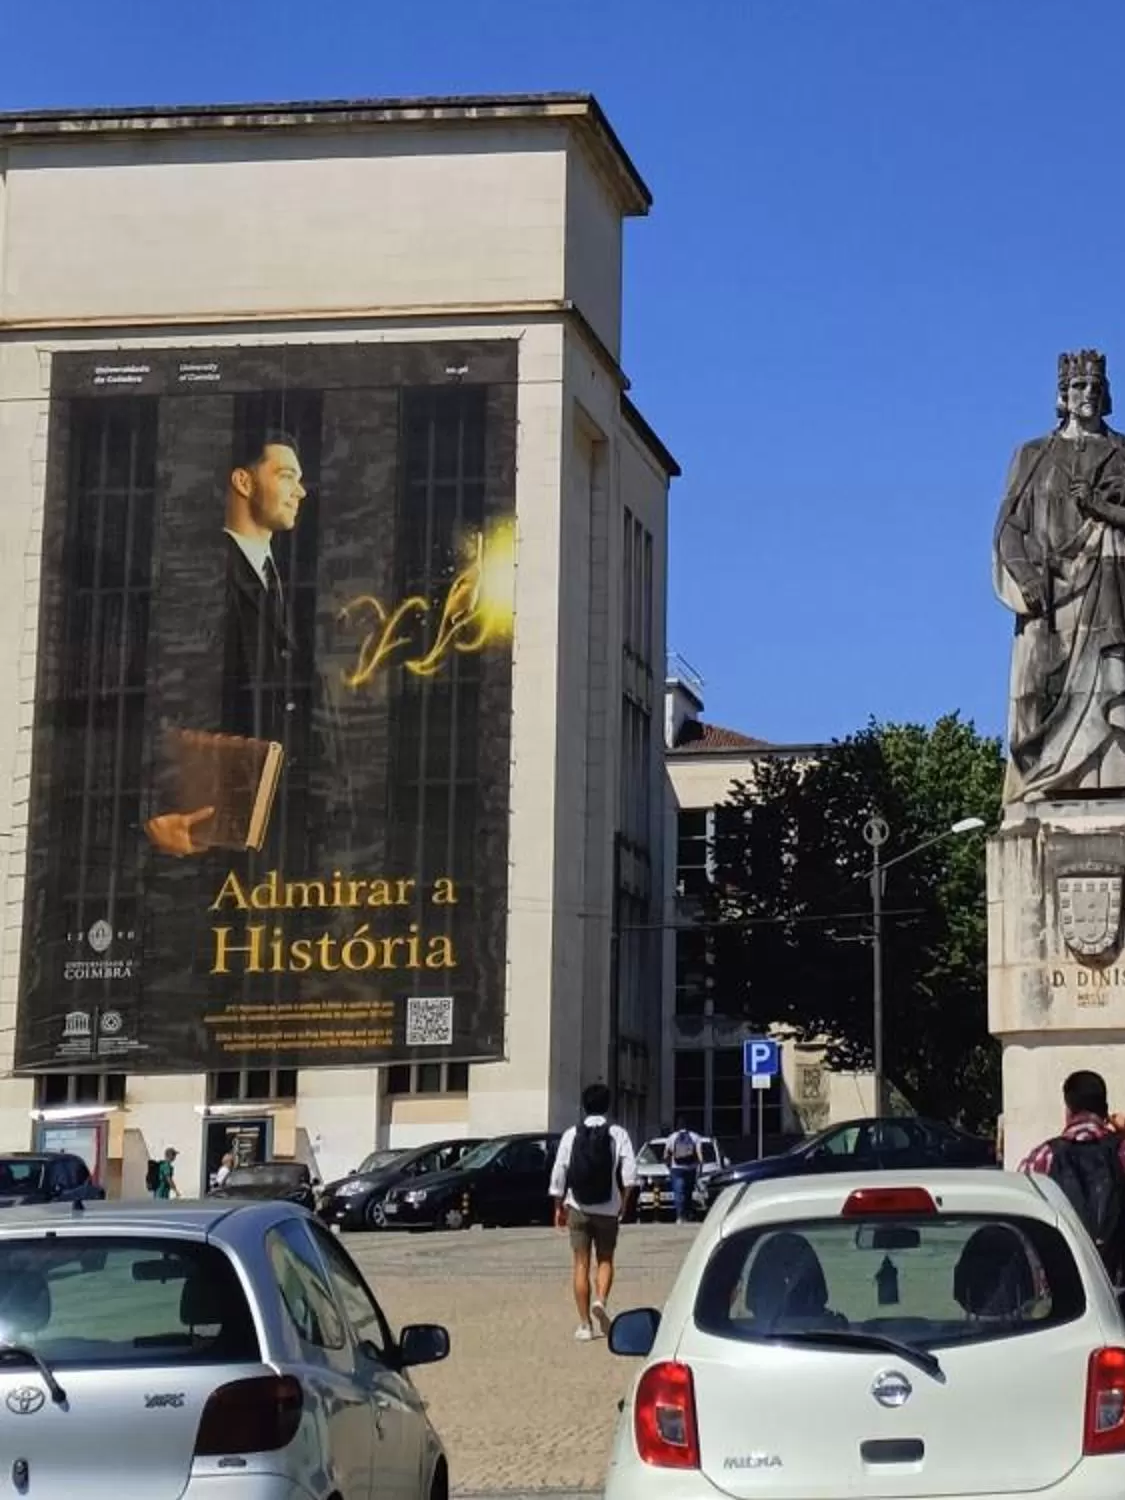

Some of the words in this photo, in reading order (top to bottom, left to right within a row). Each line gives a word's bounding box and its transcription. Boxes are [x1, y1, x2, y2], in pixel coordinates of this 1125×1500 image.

[208, 869, 415, 911] Admirar
[431, 876, 458, 905] a
[208, 923, 458, 975] História
[64, 967, 131, 980] COIMBRA
[752, 1044, 770, 1072] P
